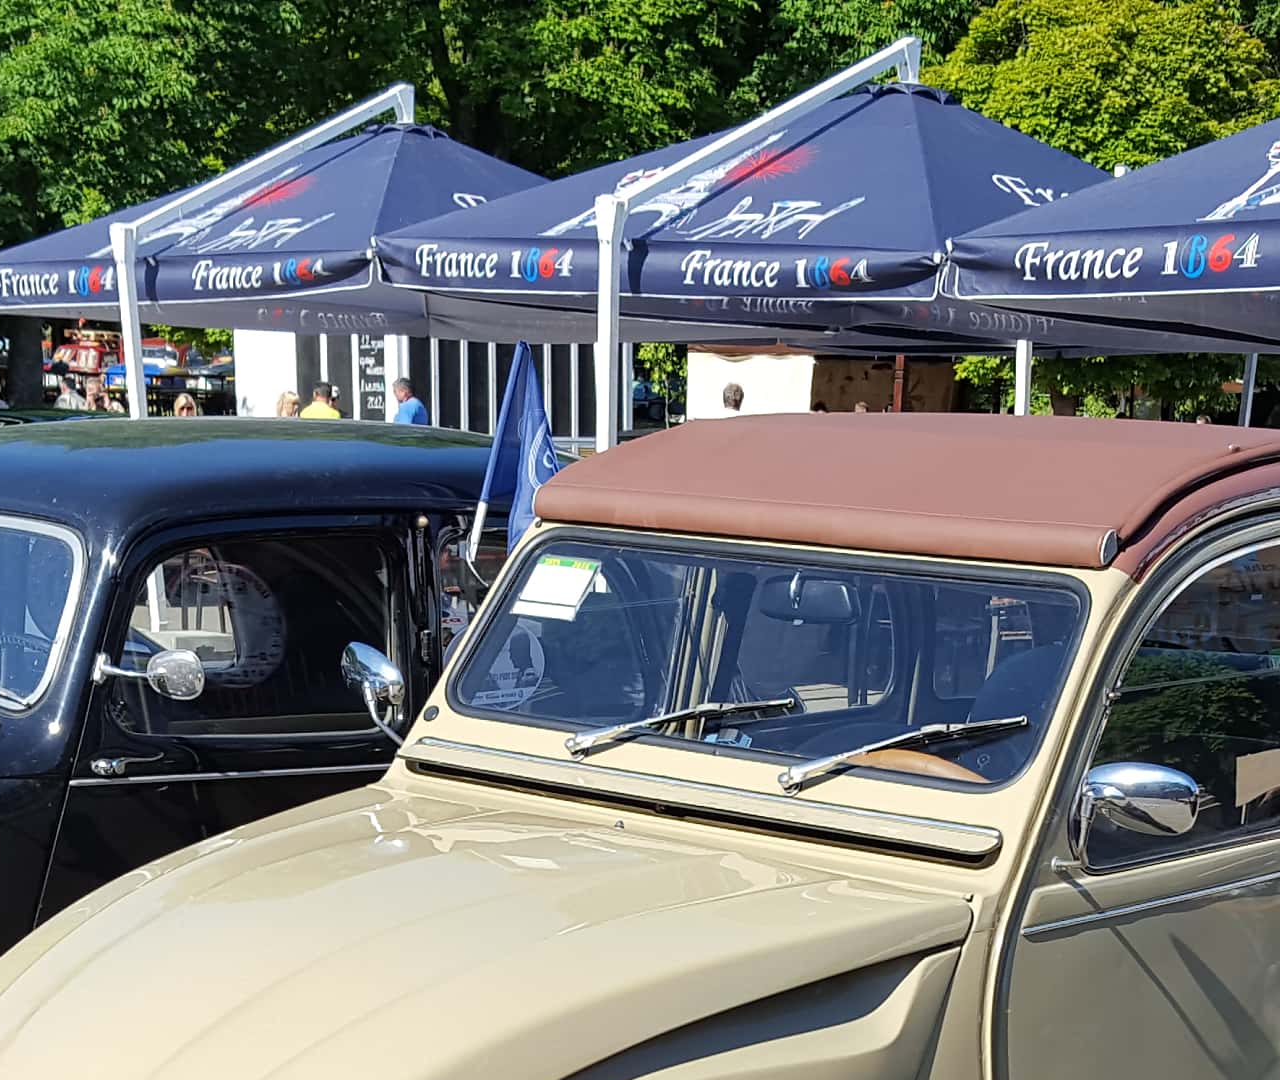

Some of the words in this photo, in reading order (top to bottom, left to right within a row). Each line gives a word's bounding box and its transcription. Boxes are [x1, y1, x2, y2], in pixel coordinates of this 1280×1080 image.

[191, 259, 262, 291] France
[415, 243, 497, 279] France
[680, 249, 780, 288] France
[1014, 240, 1144, 281] France
